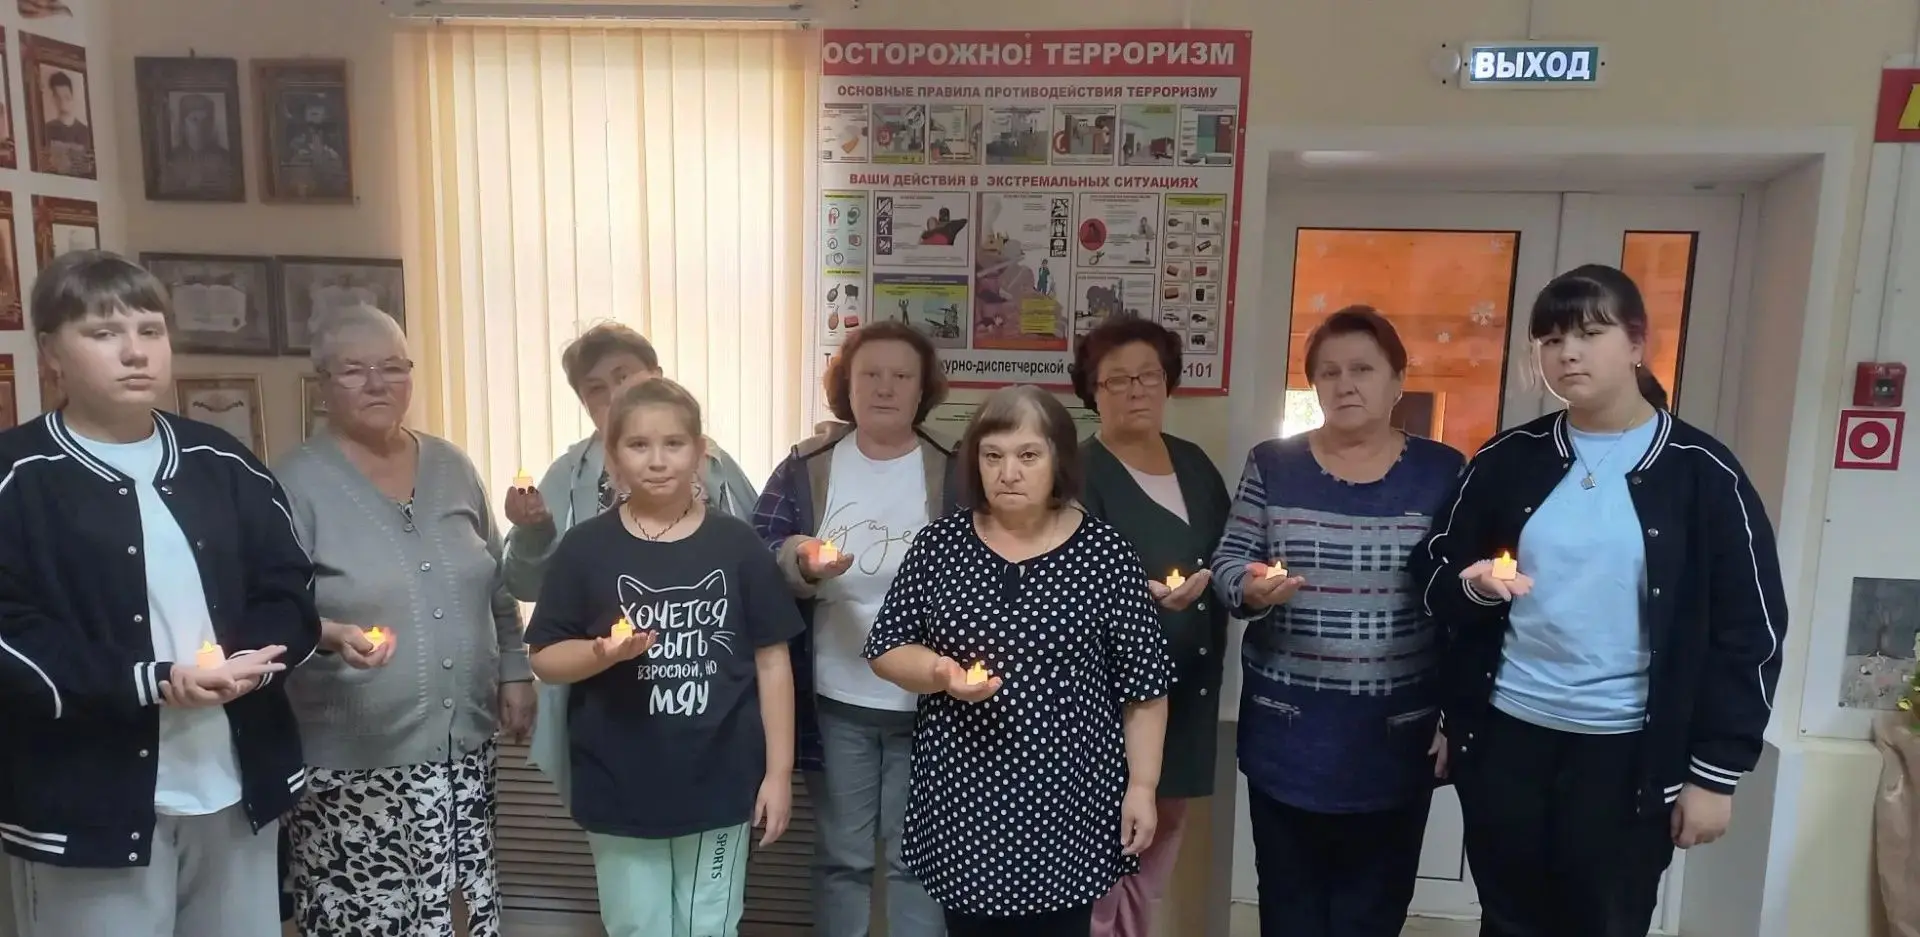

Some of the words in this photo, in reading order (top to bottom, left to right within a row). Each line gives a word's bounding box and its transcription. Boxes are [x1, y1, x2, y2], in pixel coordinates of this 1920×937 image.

[823, 41, 1032, 66] ОСТОРОЖНО!
[1042, 41, 1235, 66] ТЕРРОРИЗМ
[1474, 50, 1590, 80] ВЫХОД
[837, 84, 914, 98] ОСНОВНЫЕ
[917, 85, 981, 99] ПРАВИЛА
[984, 84, 1122, 100] ПРОТИВОДЕЙСТВИЯ
[1127, 86, 1218, 100] ТЕРРОРИЗМУ
[849, 173, 890, 186] ВАШИ
[893, 173, 966, 189] ДЕЙСТВИЯ
[970, 175, 979, 187] В
[986, 174, 1110, 189] ЭКСТРЕМАЛЬНЫХ
[1114, 175, 1199, 190] СИТУАЦИЯХ
[943, 359, 1064, 376] урно-диспетчерской
[1183, 364, 1212, 378] -101
[620, 598, 728, 630] ХОЧЕТСЯ
[647, 628, 708, 659] БЫТЬ
[637, 660, 703, 680] ВЗРОСЛОЙ,
[704, 659, 718, 675] НО
[649, 680, 709, 717] МЯУ
[711, 833, 728, 880] SPORTS
